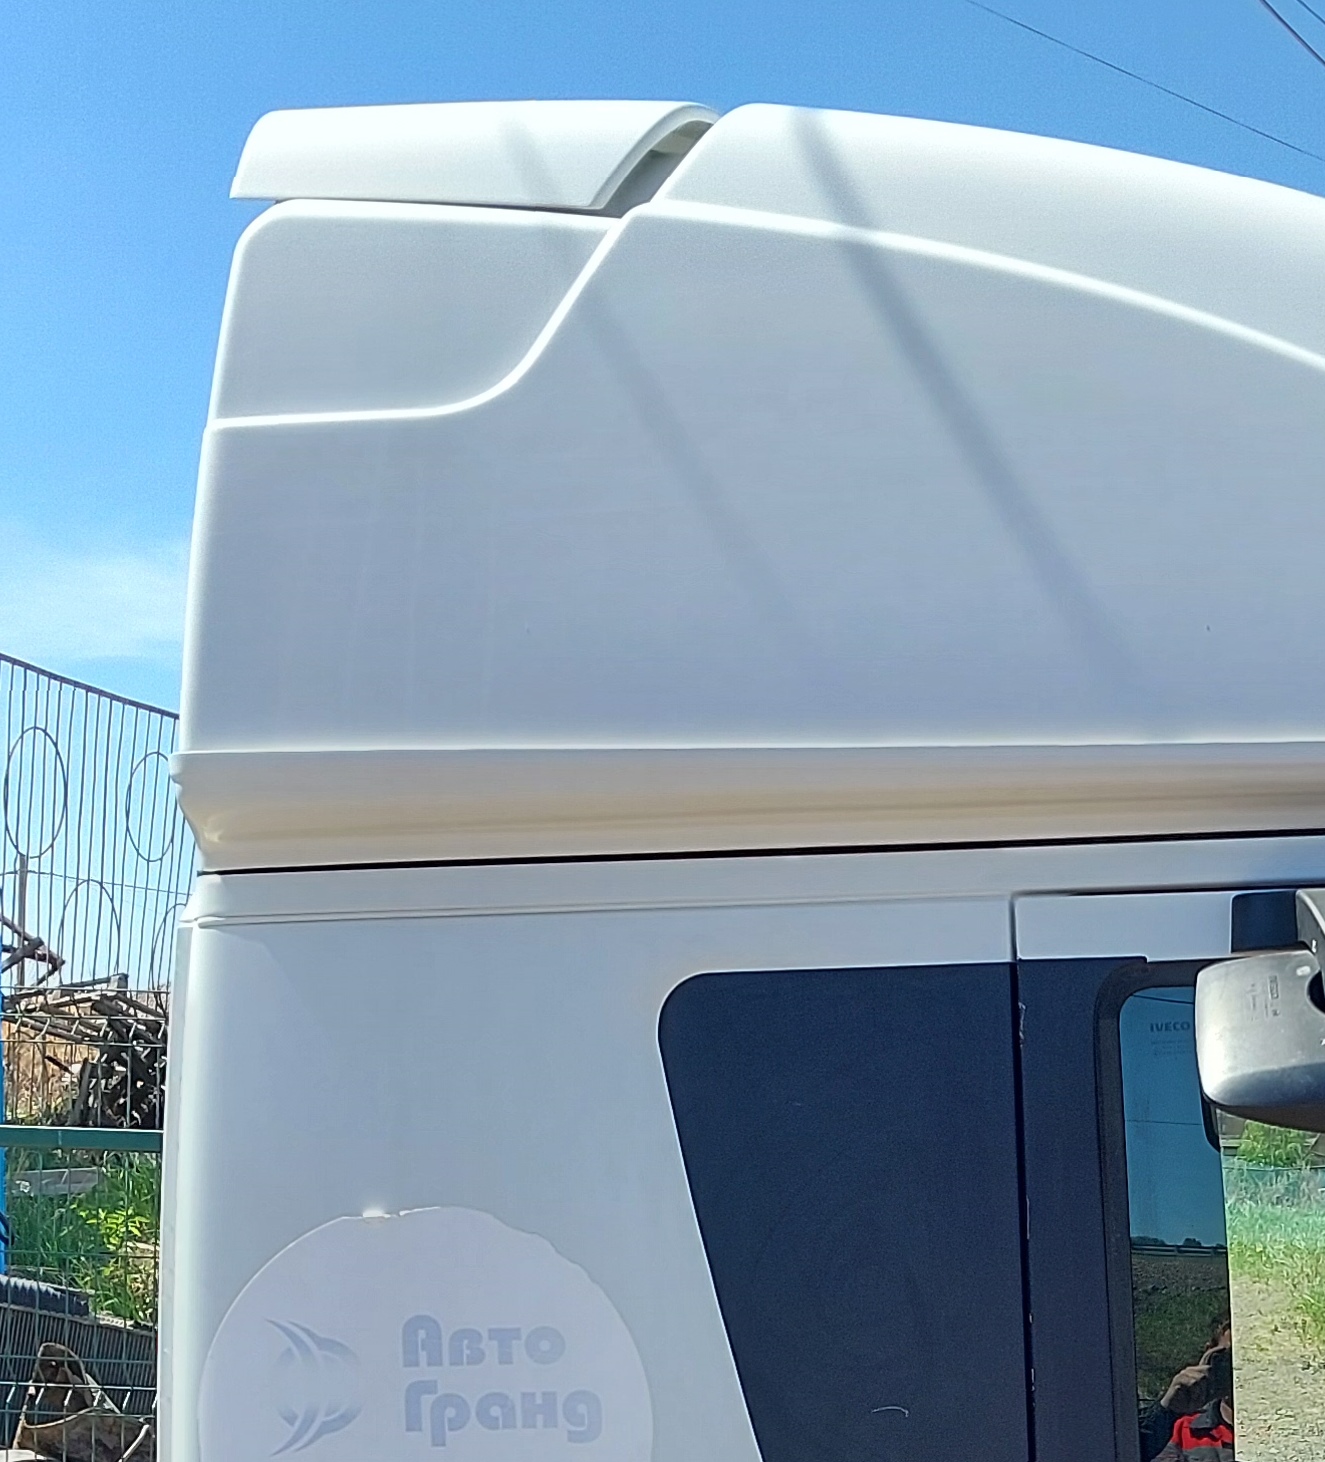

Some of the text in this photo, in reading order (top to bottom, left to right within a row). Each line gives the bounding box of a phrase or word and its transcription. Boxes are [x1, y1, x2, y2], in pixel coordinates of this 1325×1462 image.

[1150, 1021, 1191, 1033] IVECO
[401, 1314, 566, 1368] Авто
[404, 1379, 602, 1447] Гранд
